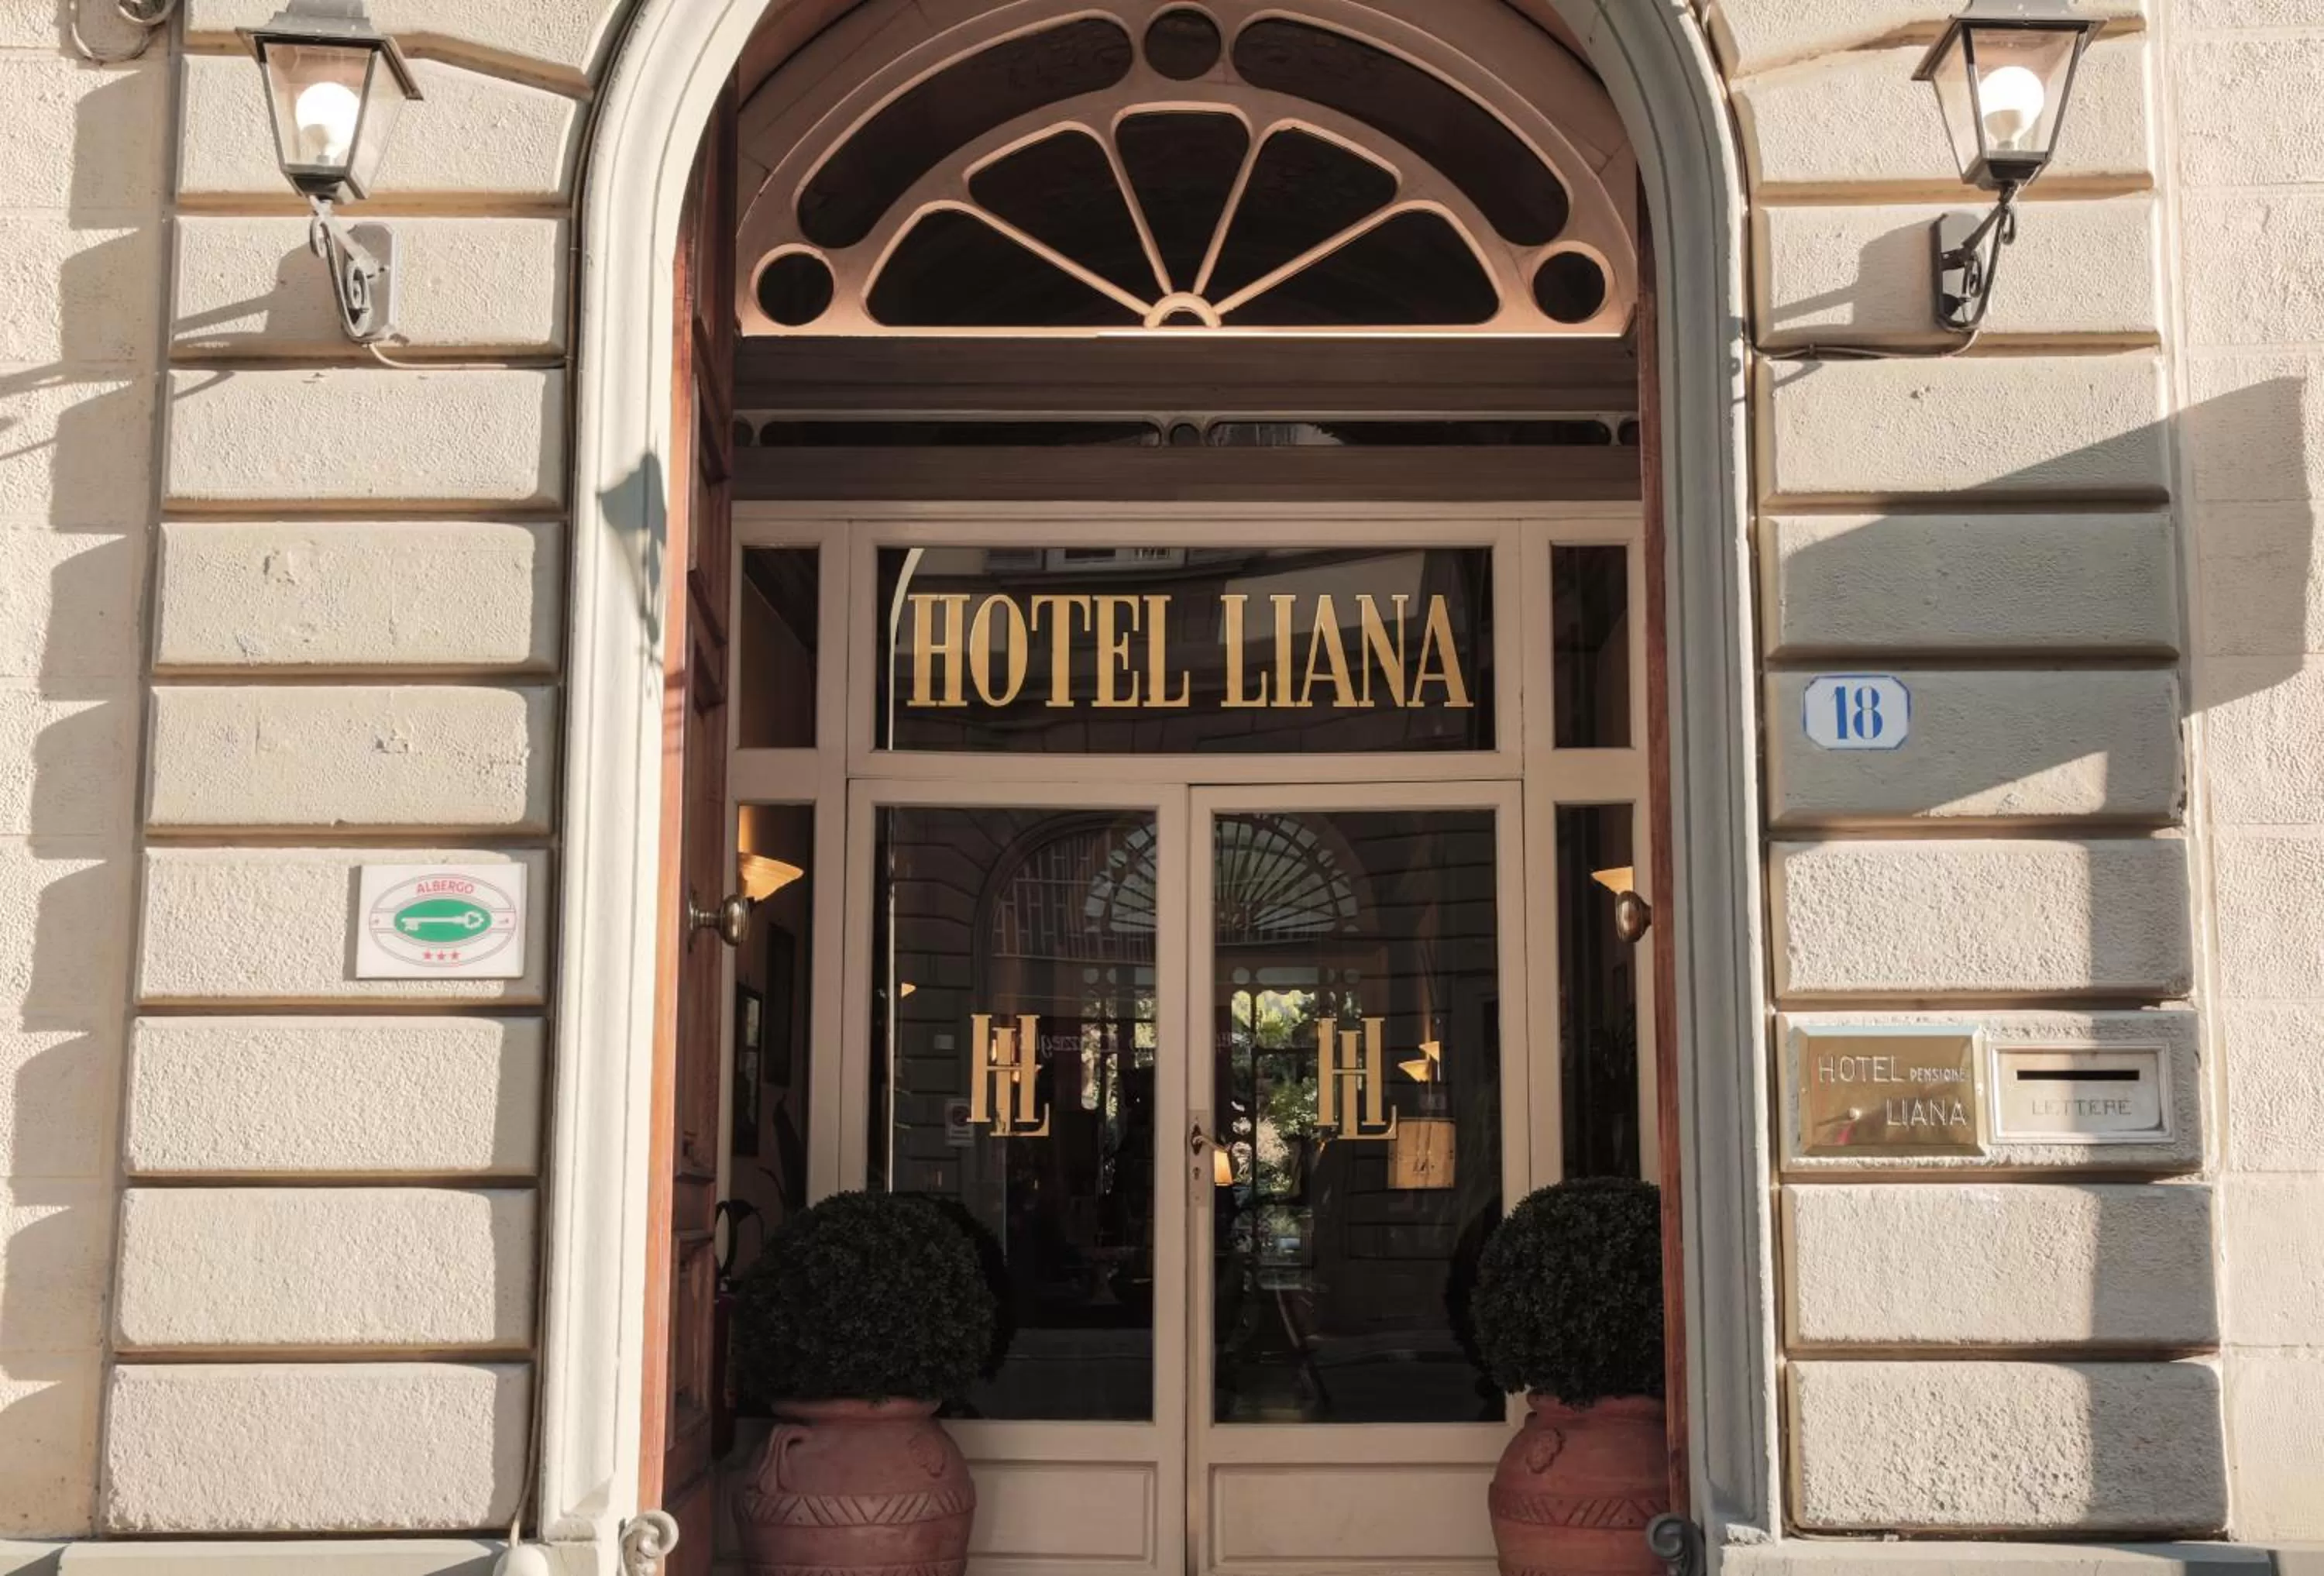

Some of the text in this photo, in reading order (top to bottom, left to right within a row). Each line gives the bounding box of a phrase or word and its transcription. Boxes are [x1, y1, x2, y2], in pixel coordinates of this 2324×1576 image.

[907, 594, 1473, 707] HOTEL LIANA
[1834, 685, 1883, 739] 18
[416, 879, 474, 894] ALBERGO
[1818, 1055, 1966, 1082] HOTEL PENSIONE
[1886, 1098, 1966, 1126] LIANA
[2032, 1099, 2132, 1116] LETTERE
